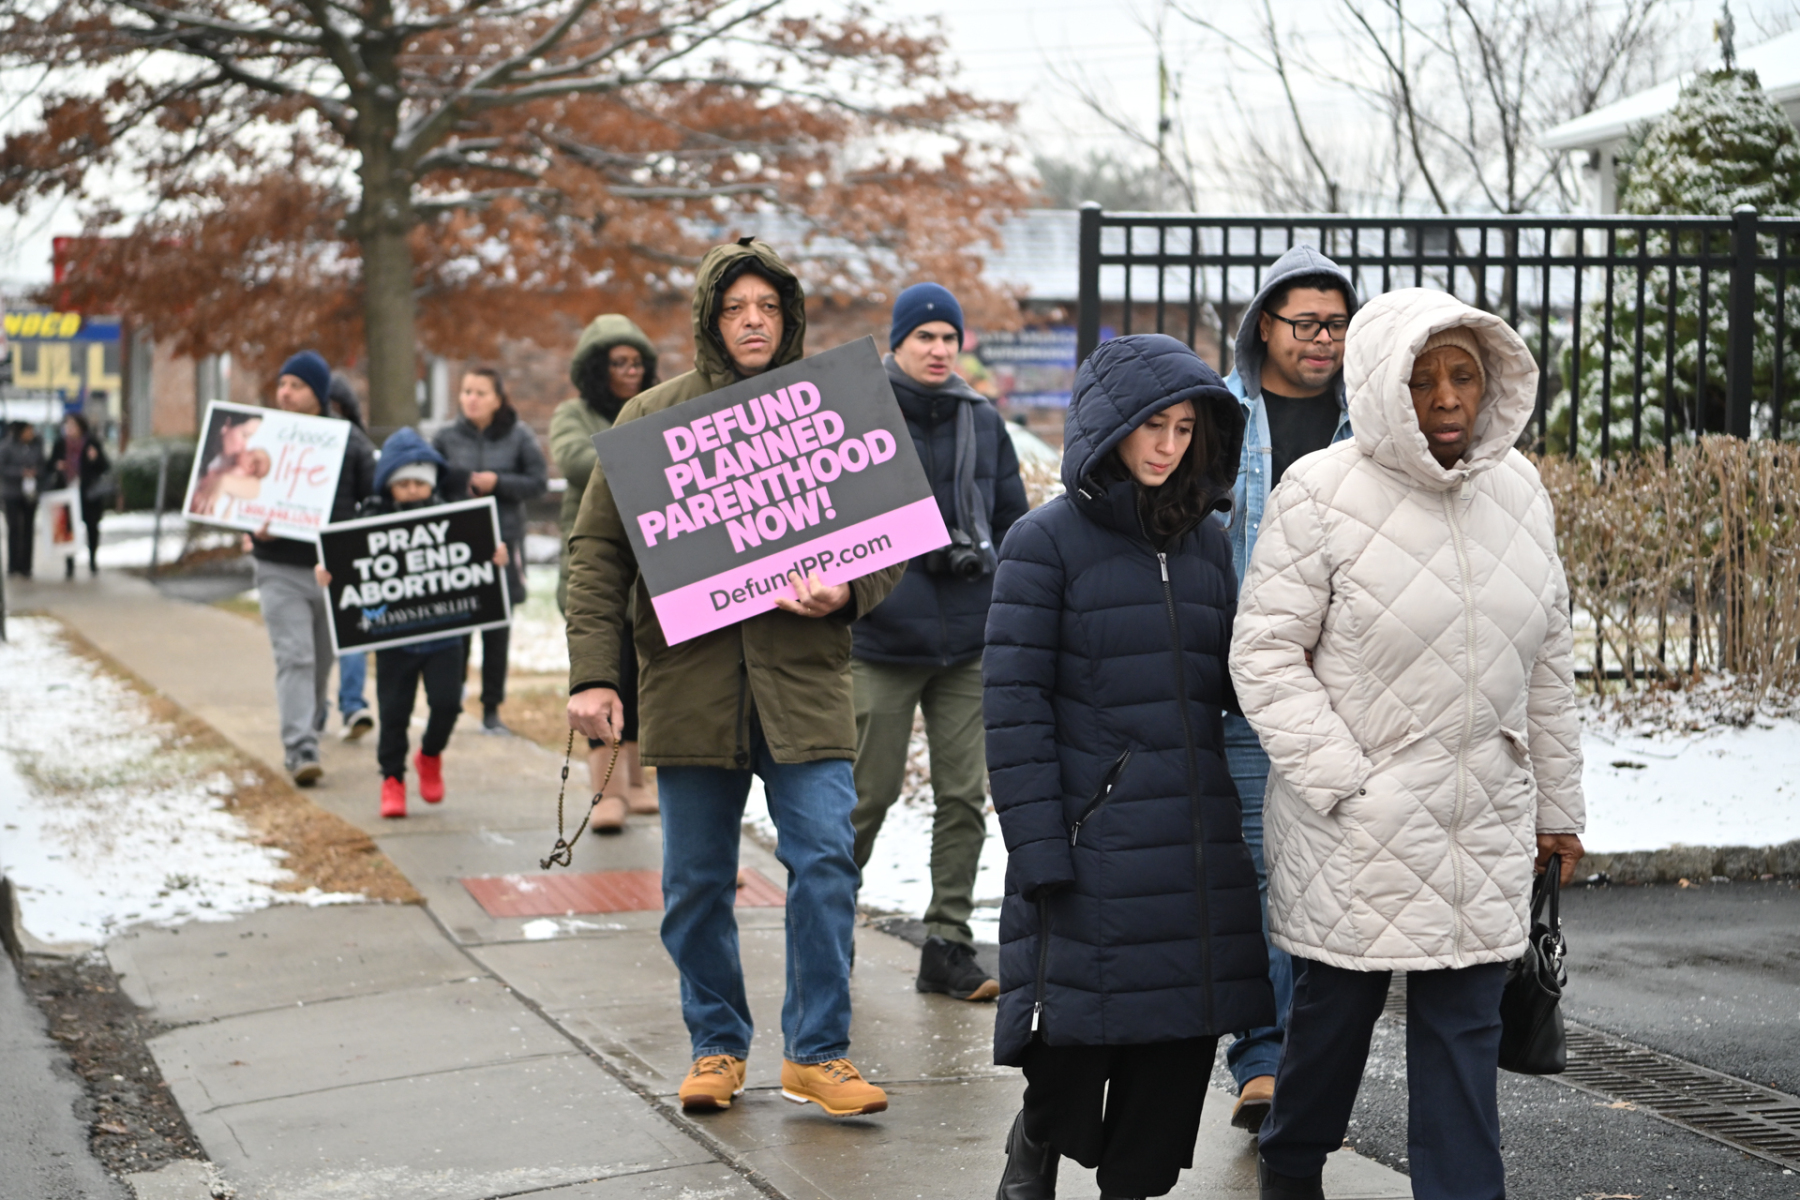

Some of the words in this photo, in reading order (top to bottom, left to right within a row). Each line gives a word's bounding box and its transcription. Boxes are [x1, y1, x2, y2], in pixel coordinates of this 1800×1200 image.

[278, 421, 339, 448] choose
[663, 381, 821, 463] DEFUND
[274, 444, 330, 500] life
[664, 410, 845, 500] PLANNED
[637, 428, 897, 548] PARENTHOOD
[367, 519, 450, 555] PRAY
[725, 486, 837, 553] NOW!
[339, 560, 494, 611] ABORTION
[353, 554, 398, 581] TO
[405, 542, 471, 573] END
[709, 534, 893, 611] DefundPP.com
